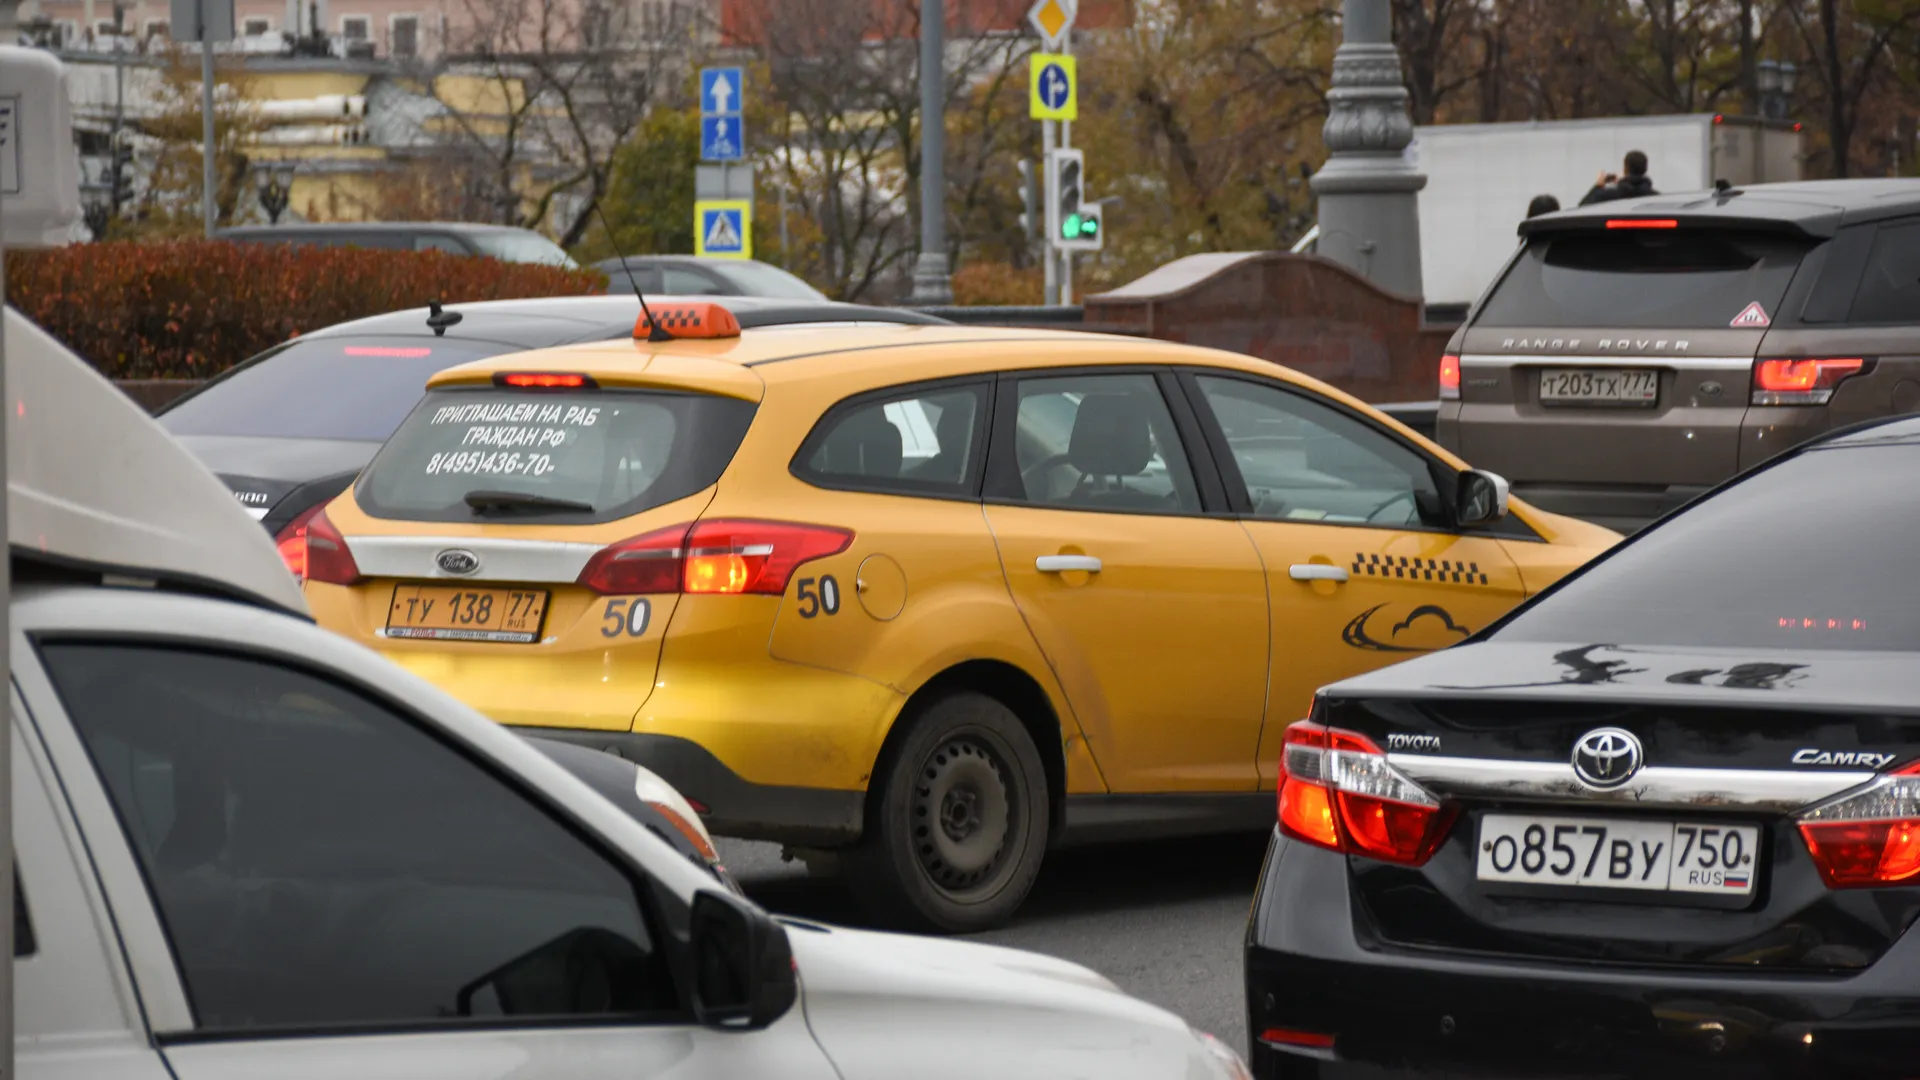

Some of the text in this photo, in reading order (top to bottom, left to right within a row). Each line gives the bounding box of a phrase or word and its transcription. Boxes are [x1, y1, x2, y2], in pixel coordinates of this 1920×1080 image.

[1502, 338, 1690, 351] RANGE ROVER
[1548, 372, 1651, 396] Т203ТХ 777
[431, 404, 600, 426] ПРИГЛАШАЕМ НА РАБ
[462, 426, 566, 448] ГРАЖДАН РФ
[426, 451, 555, 476] 8(495)436-70-
[443, 555, 468, 569] Ford
[797, 574, 840, 619] 50
[406, 592, 537, 625] ТУ 138 77
[600, 597, 651, 638] 50
[507, 618, 527, 629] RUS
[1387, 734, 1441, 751] TOYOTA
[1792, 749, 1897, 769] CAMRY
[1491, 824, 1743, 881] О857ВУ 750
[1688, 870, 1723, 886] RUS
